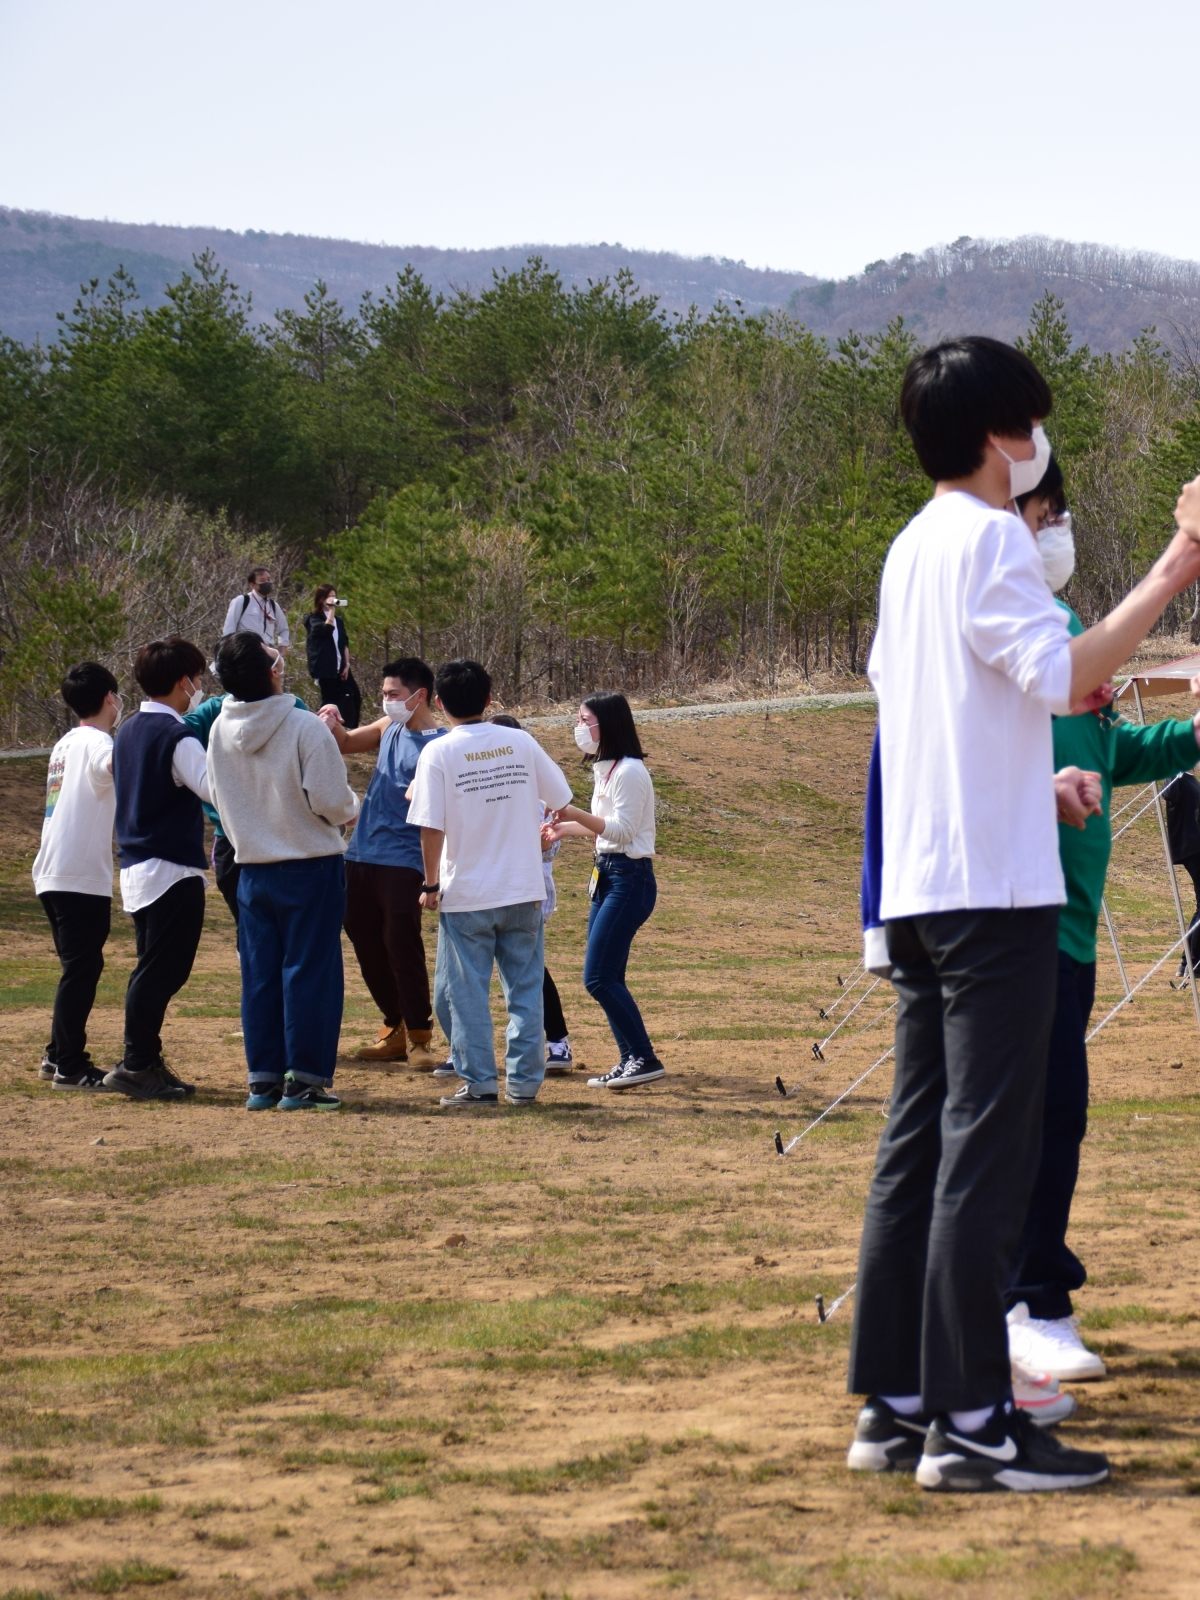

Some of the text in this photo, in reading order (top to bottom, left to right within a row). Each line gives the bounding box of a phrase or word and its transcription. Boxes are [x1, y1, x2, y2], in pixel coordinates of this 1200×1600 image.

[464, 746, 513, 762] WARNING
[493, 772, 512, 780] TRIGGER
[480, 782, 505, 790] DISCRETION
